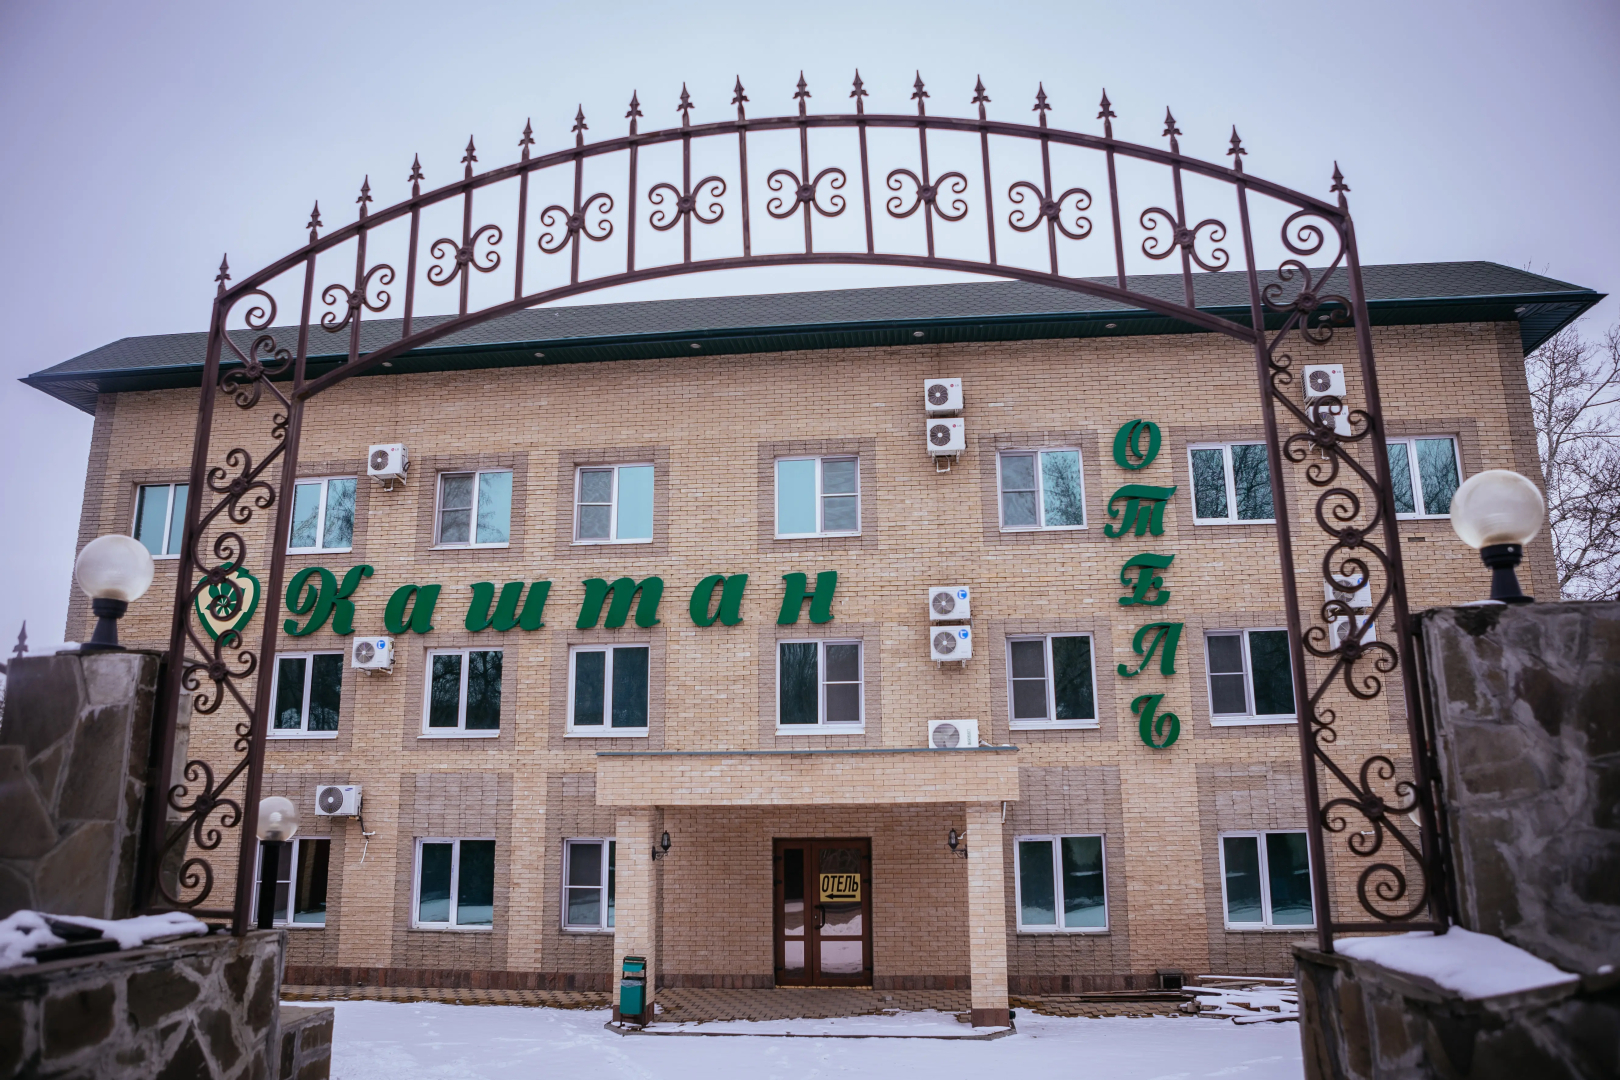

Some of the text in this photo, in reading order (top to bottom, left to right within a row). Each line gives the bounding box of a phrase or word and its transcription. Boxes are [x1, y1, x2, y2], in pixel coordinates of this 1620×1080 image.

[283, 564, 838, 636] Каштан
[1103, 418, 1184, 749] ОТЕЛЬ
[821, 875, 859, 893] ОТЕЛЬ
